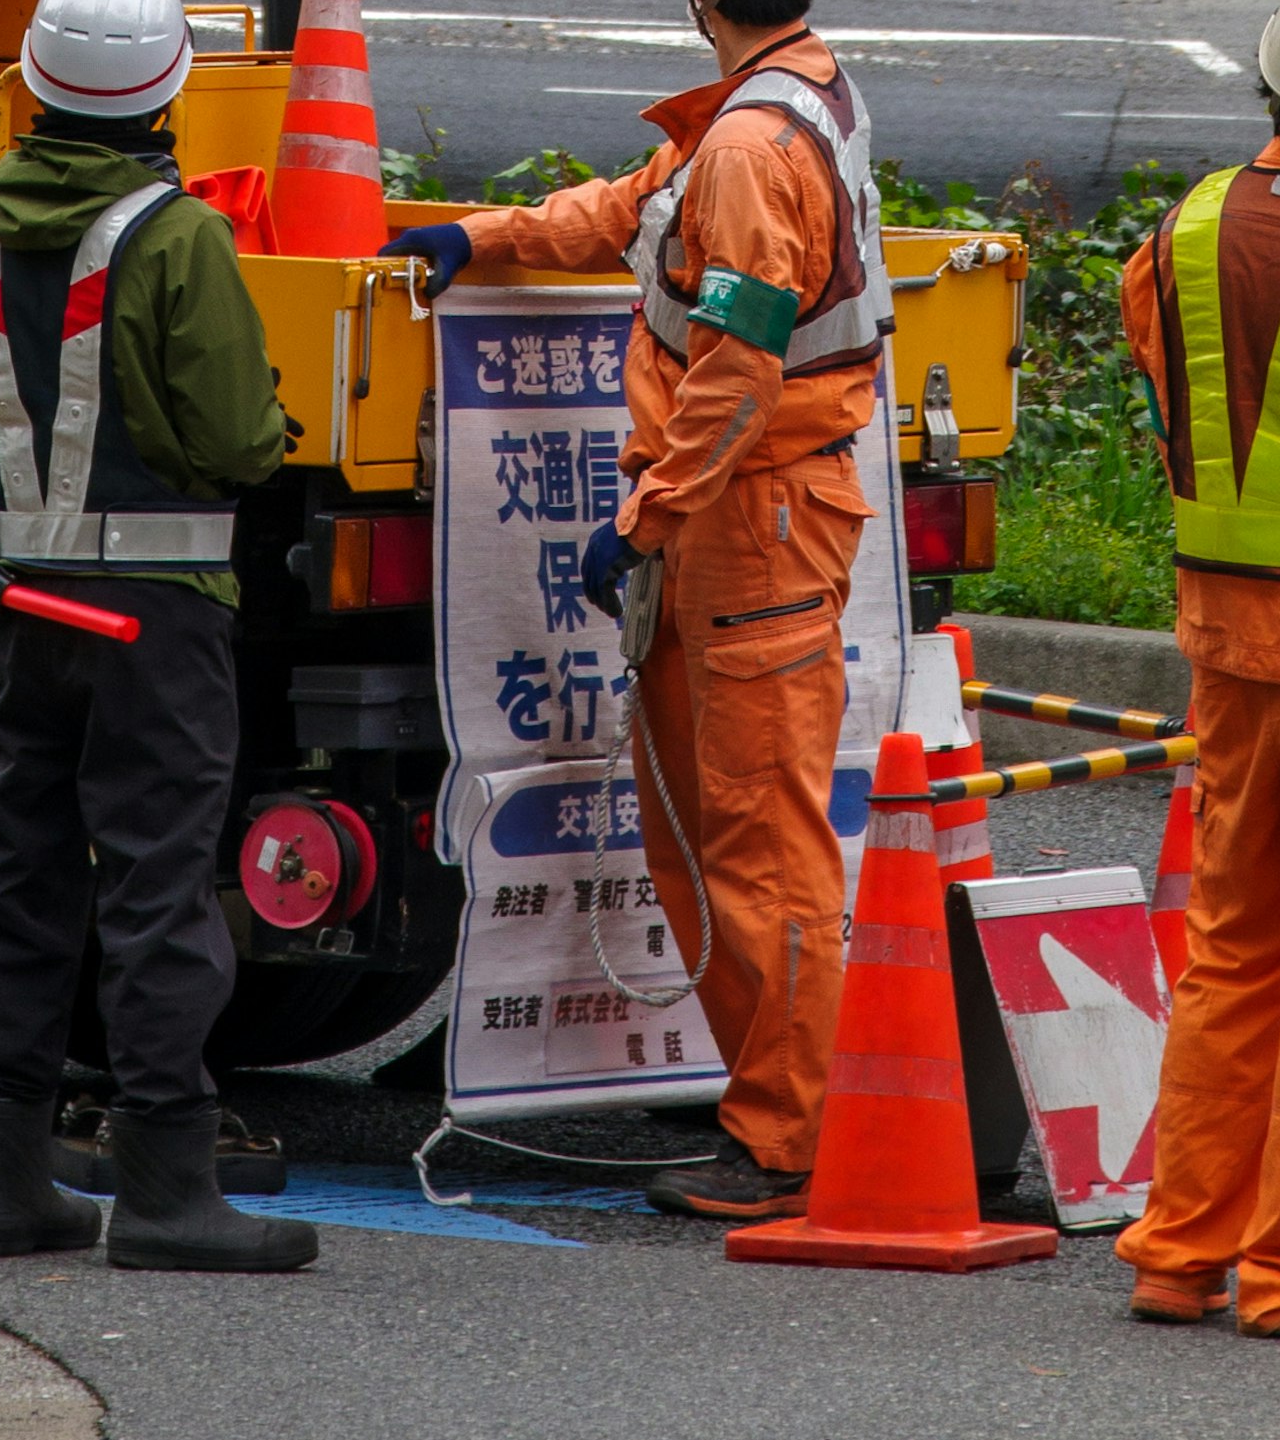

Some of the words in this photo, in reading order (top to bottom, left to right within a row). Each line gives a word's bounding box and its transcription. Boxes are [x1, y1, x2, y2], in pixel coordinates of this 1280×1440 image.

[477, 334, 629, 396] ご迷惑を
[491, 882, 548, 918] 発注者
[634, 875, 663, 909] 交
[482, 994, 543, 1031] 受託者
[554, 991, 631, 1028] 株式会社
